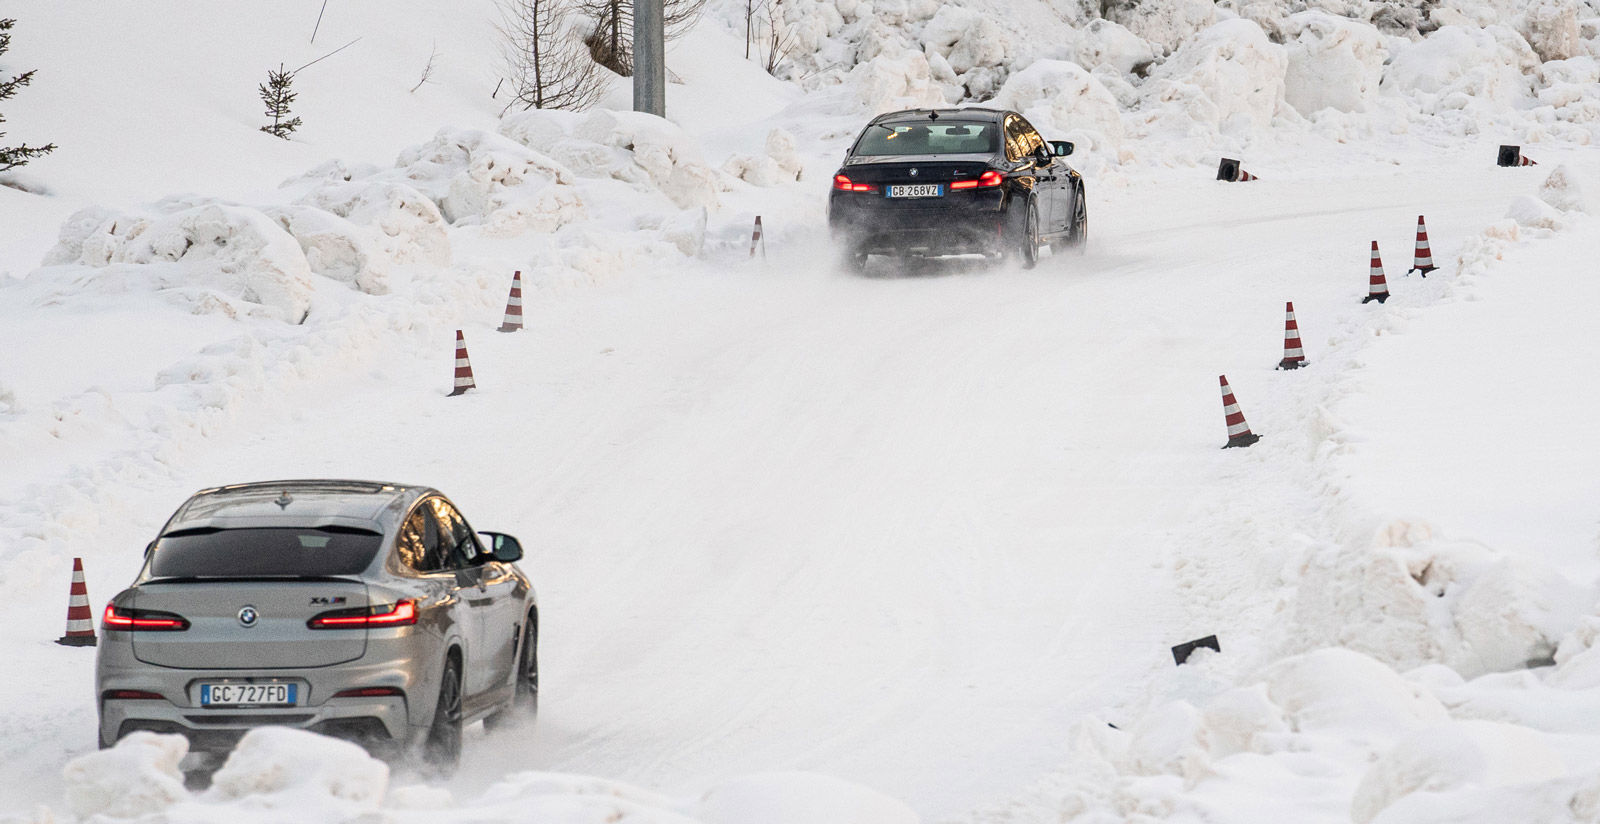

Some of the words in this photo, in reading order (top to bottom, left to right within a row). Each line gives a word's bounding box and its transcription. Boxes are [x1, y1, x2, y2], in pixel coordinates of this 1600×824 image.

[892, 186, 905, 196] GB
[907, 185, 937, 196] 268VZ
[212, 686, 231, 702] GC
[237, 685, 286, 702] 727FD
